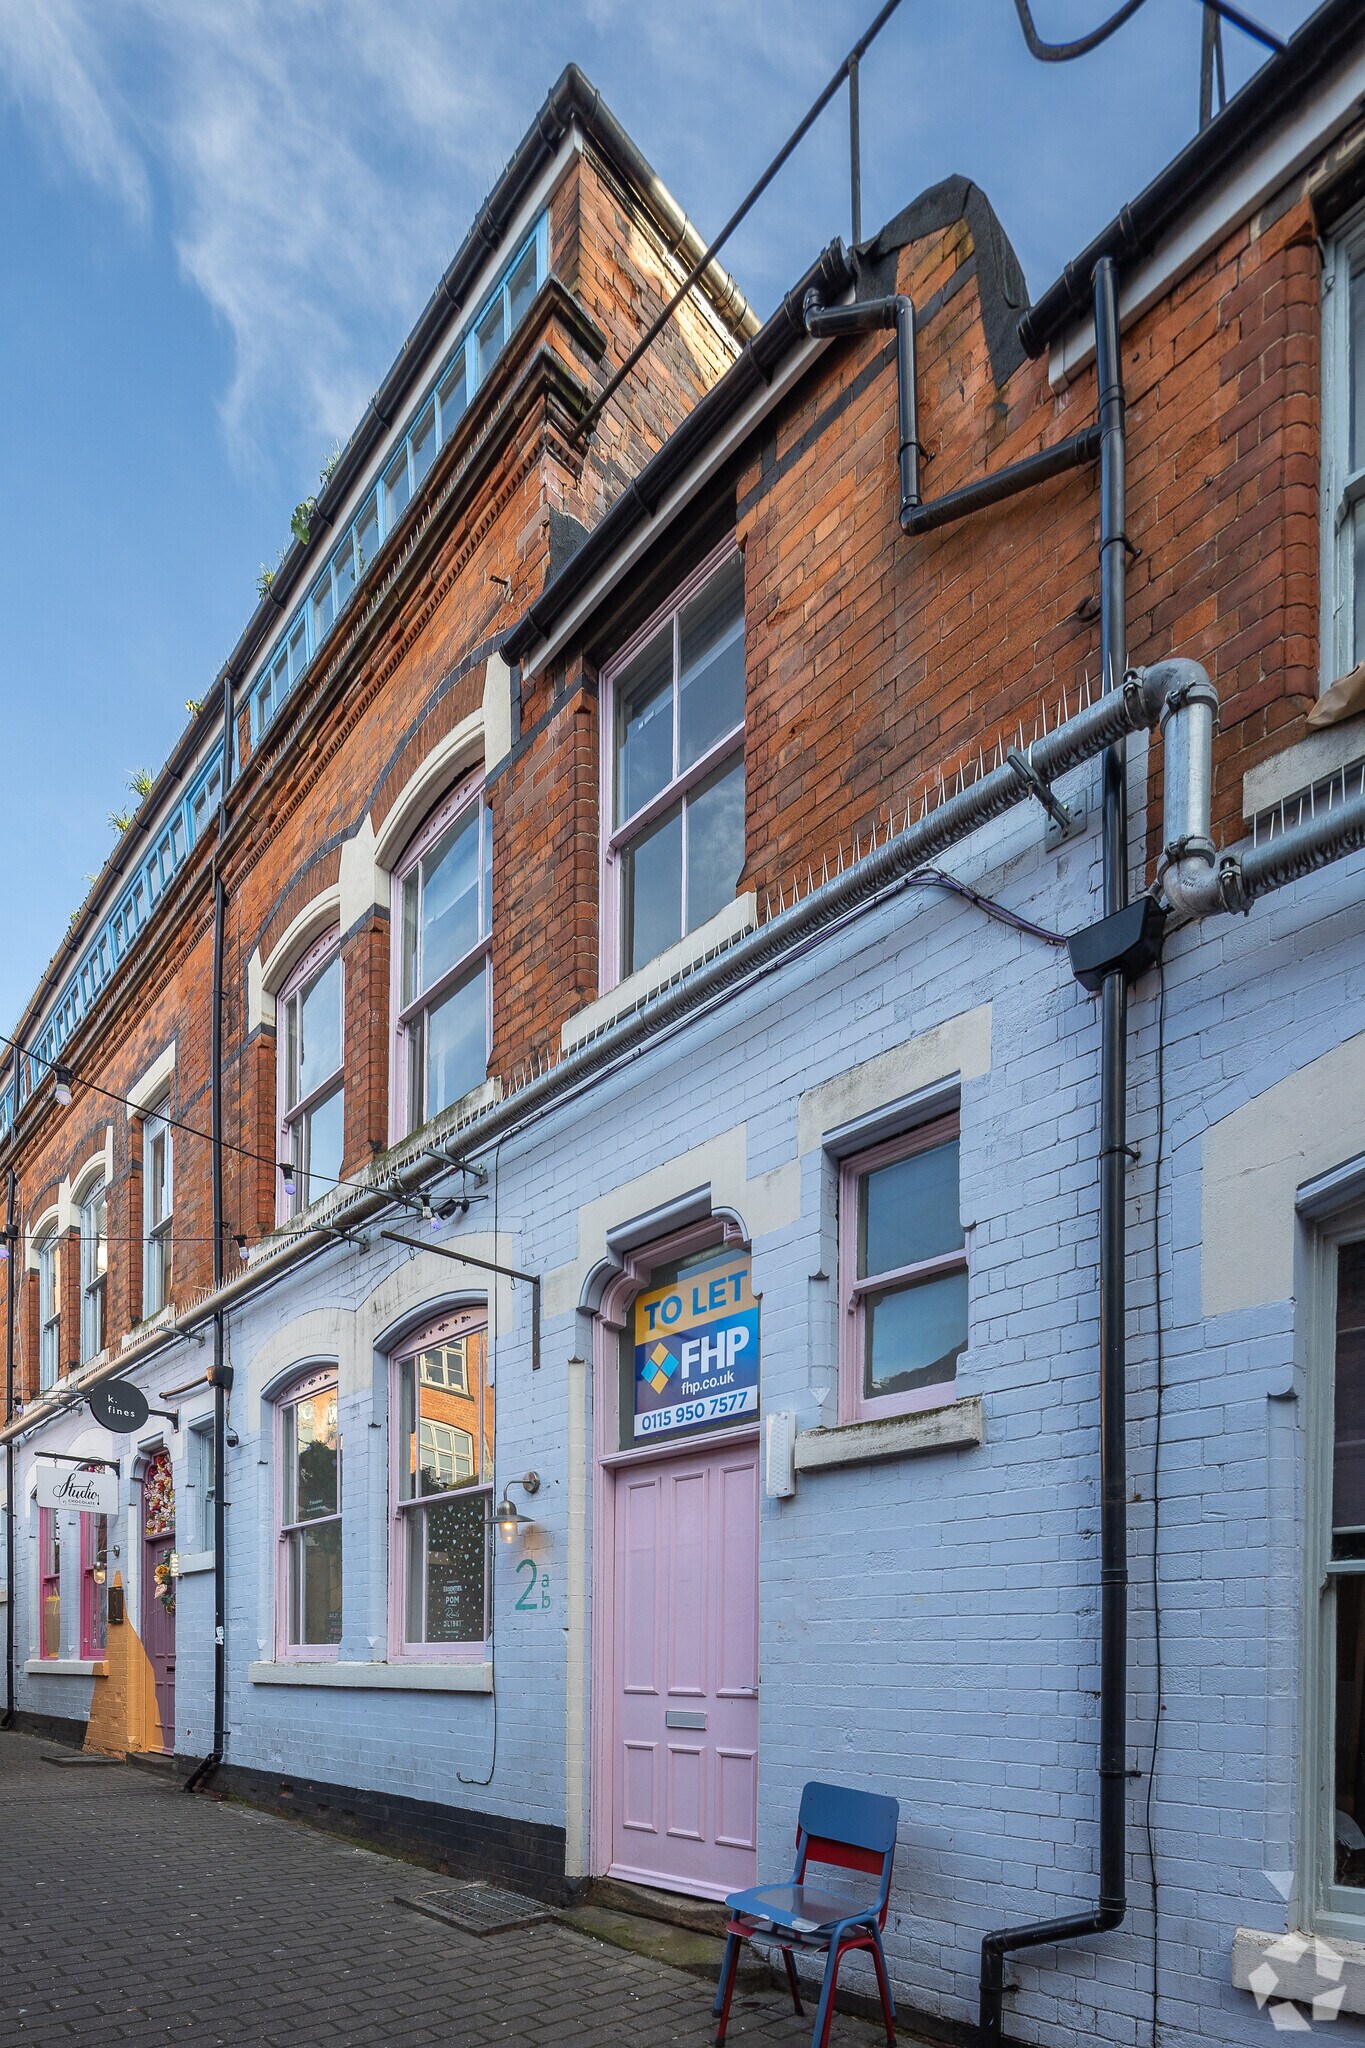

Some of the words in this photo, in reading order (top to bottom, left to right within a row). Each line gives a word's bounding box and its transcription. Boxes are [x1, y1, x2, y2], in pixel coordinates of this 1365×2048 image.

[644, 1295, 683, 1331] TO
[692, 1269, 748, 1316] LET
[681, 1325, 750, 1380] FHP
[681, 1371, 735, 1396] fhp.co.uk
[107, 1394, 118, 1404] k.
[107, 1405, 136, 1418] fines
[641, 1410, 671, 1431] 0115
[676, 1402, 705, 1423] 950
[709, 1391, 748, 1416] 7577
[52, 1472, 99, 1501] Studio
[445, 1595, 460, 1605] POM
